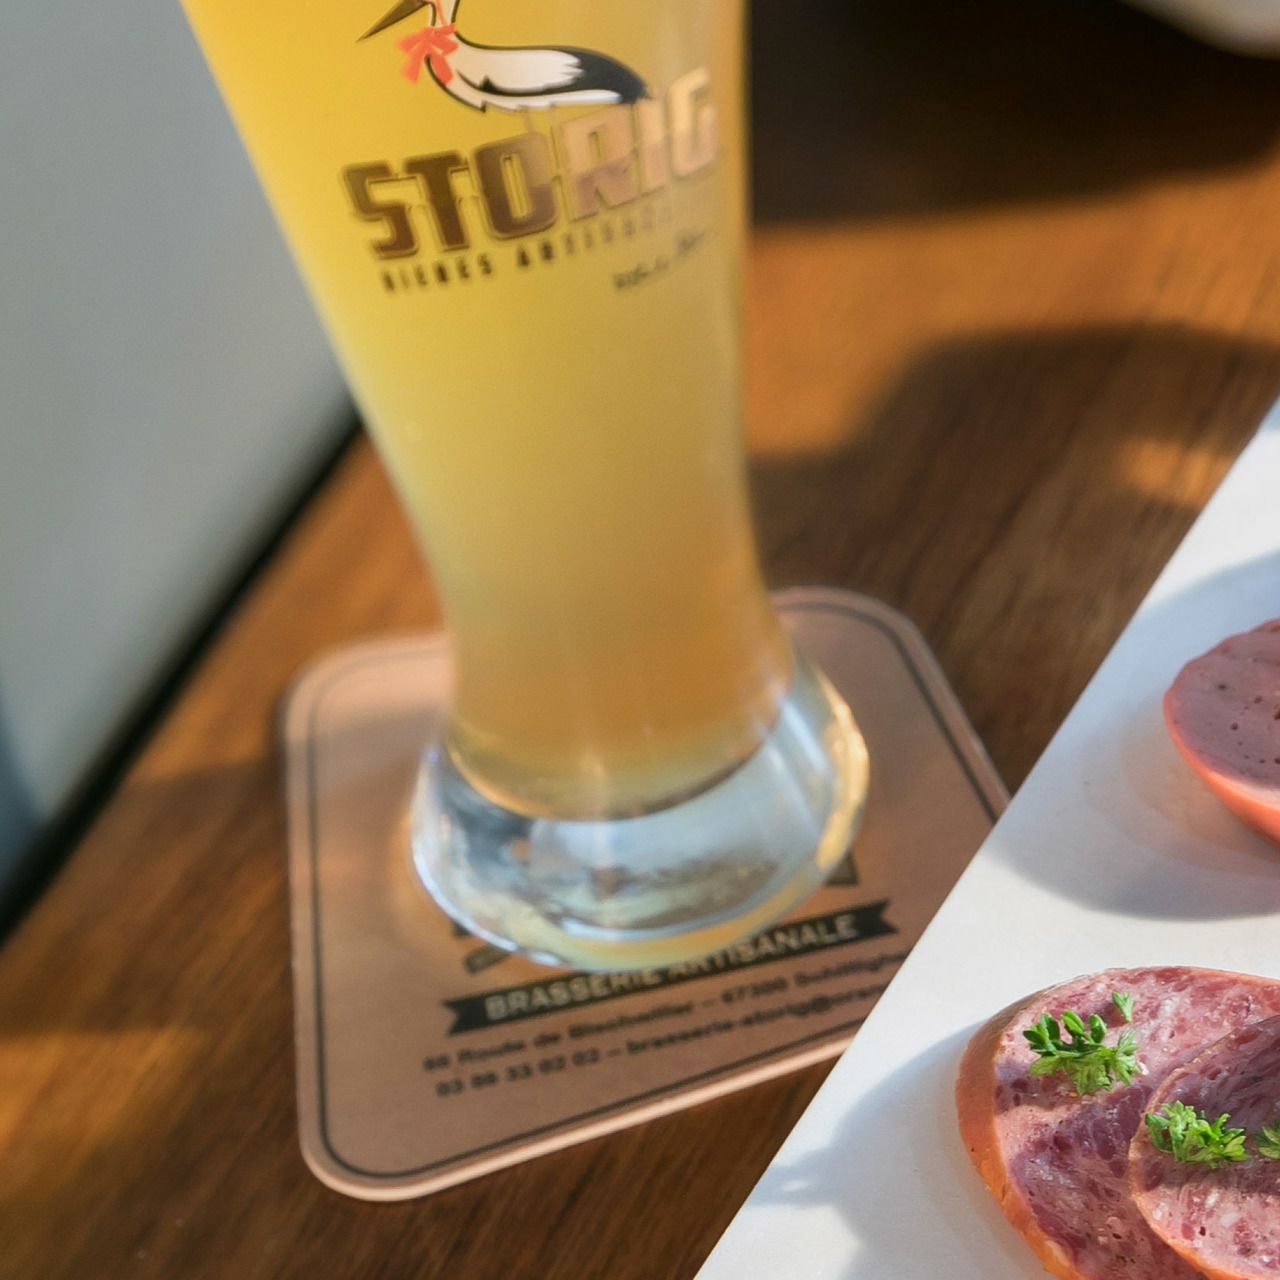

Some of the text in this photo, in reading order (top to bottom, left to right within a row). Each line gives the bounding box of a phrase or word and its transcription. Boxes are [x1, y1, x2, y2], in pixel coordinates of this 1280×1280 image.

[341, 66, 720, 260] STORIG
[484, 968, 664, 1021] BRASSERIE
[456, 1039, 527, 1064] Route
[533, 1031, 562, 1048] de
